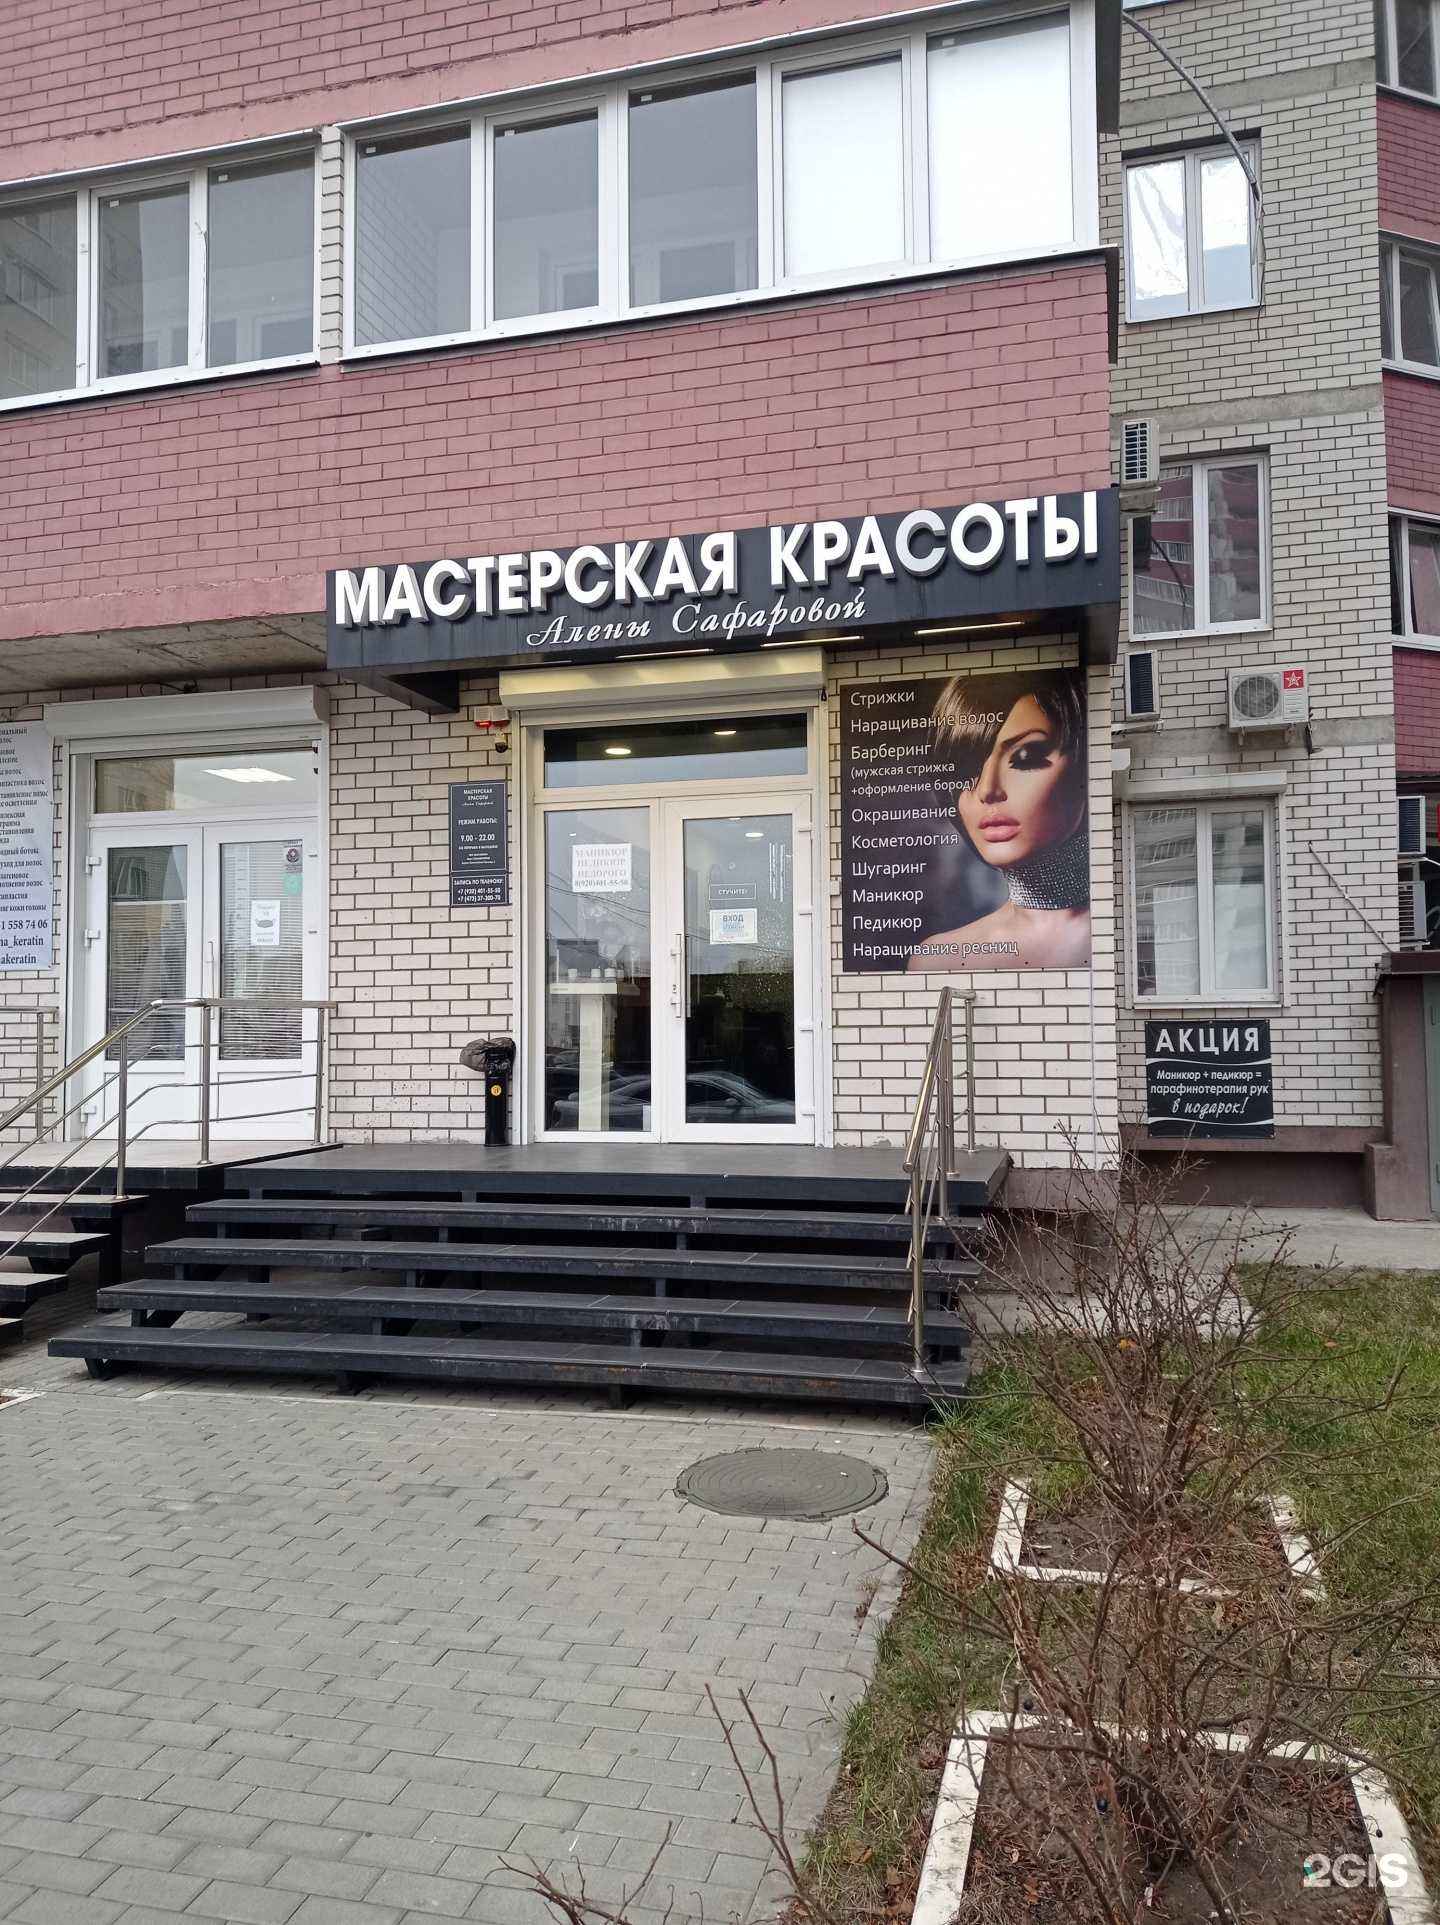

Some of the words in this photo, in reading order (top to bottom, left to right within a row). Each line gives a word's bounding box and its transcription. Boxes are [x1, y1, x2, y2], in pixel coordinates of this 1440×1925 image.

[333, 531, 740, 627] МАСТЕРСКАЯ
[769, 491, 1099, 587] КРАСОТЫ
[526, 612, 652, 646] Алены
[672, 586, 867, 640] Сафаровой
[851, 691, 915, 709] Стрижки
[851, 713, 955, 735] Наращивание
[958, 711, 1005, 726] волос
[851, 743, 931, 763] Барберинг
[851, 764, 903, 779] (мужская
[906, 762, 955, 777] стрижка
[851, 781, 931, 797] +оформление
[934, 777, 976, 795] бород)
[851, 804, 957, 824] Окрашивание
[851, 833, 959, 850] Косметология
[851, 860, 927, 879] Шугаринг
[852, 888, 924, 906] Маникюр
[8, 920, 23, 930] 558
[37, 919, 48, 929] 06
[852, 915, 922, 933] Педикюр
[852, 940, 958, 960] Наращивание
[962, 939, 1019, 956] ресниц
[1155, 1027, 1259, 1055] АКЦИЯ
[1156, 1069, 1201, 1081] Маникюр
[1211, 1070, 1253, 1082] педикюр
[1150, 1083, 1248, 1097] парафинотерапия
[1250, 1084, 1269, 1097] рук
[1185, 1096, 1250, 1119] подарок!
